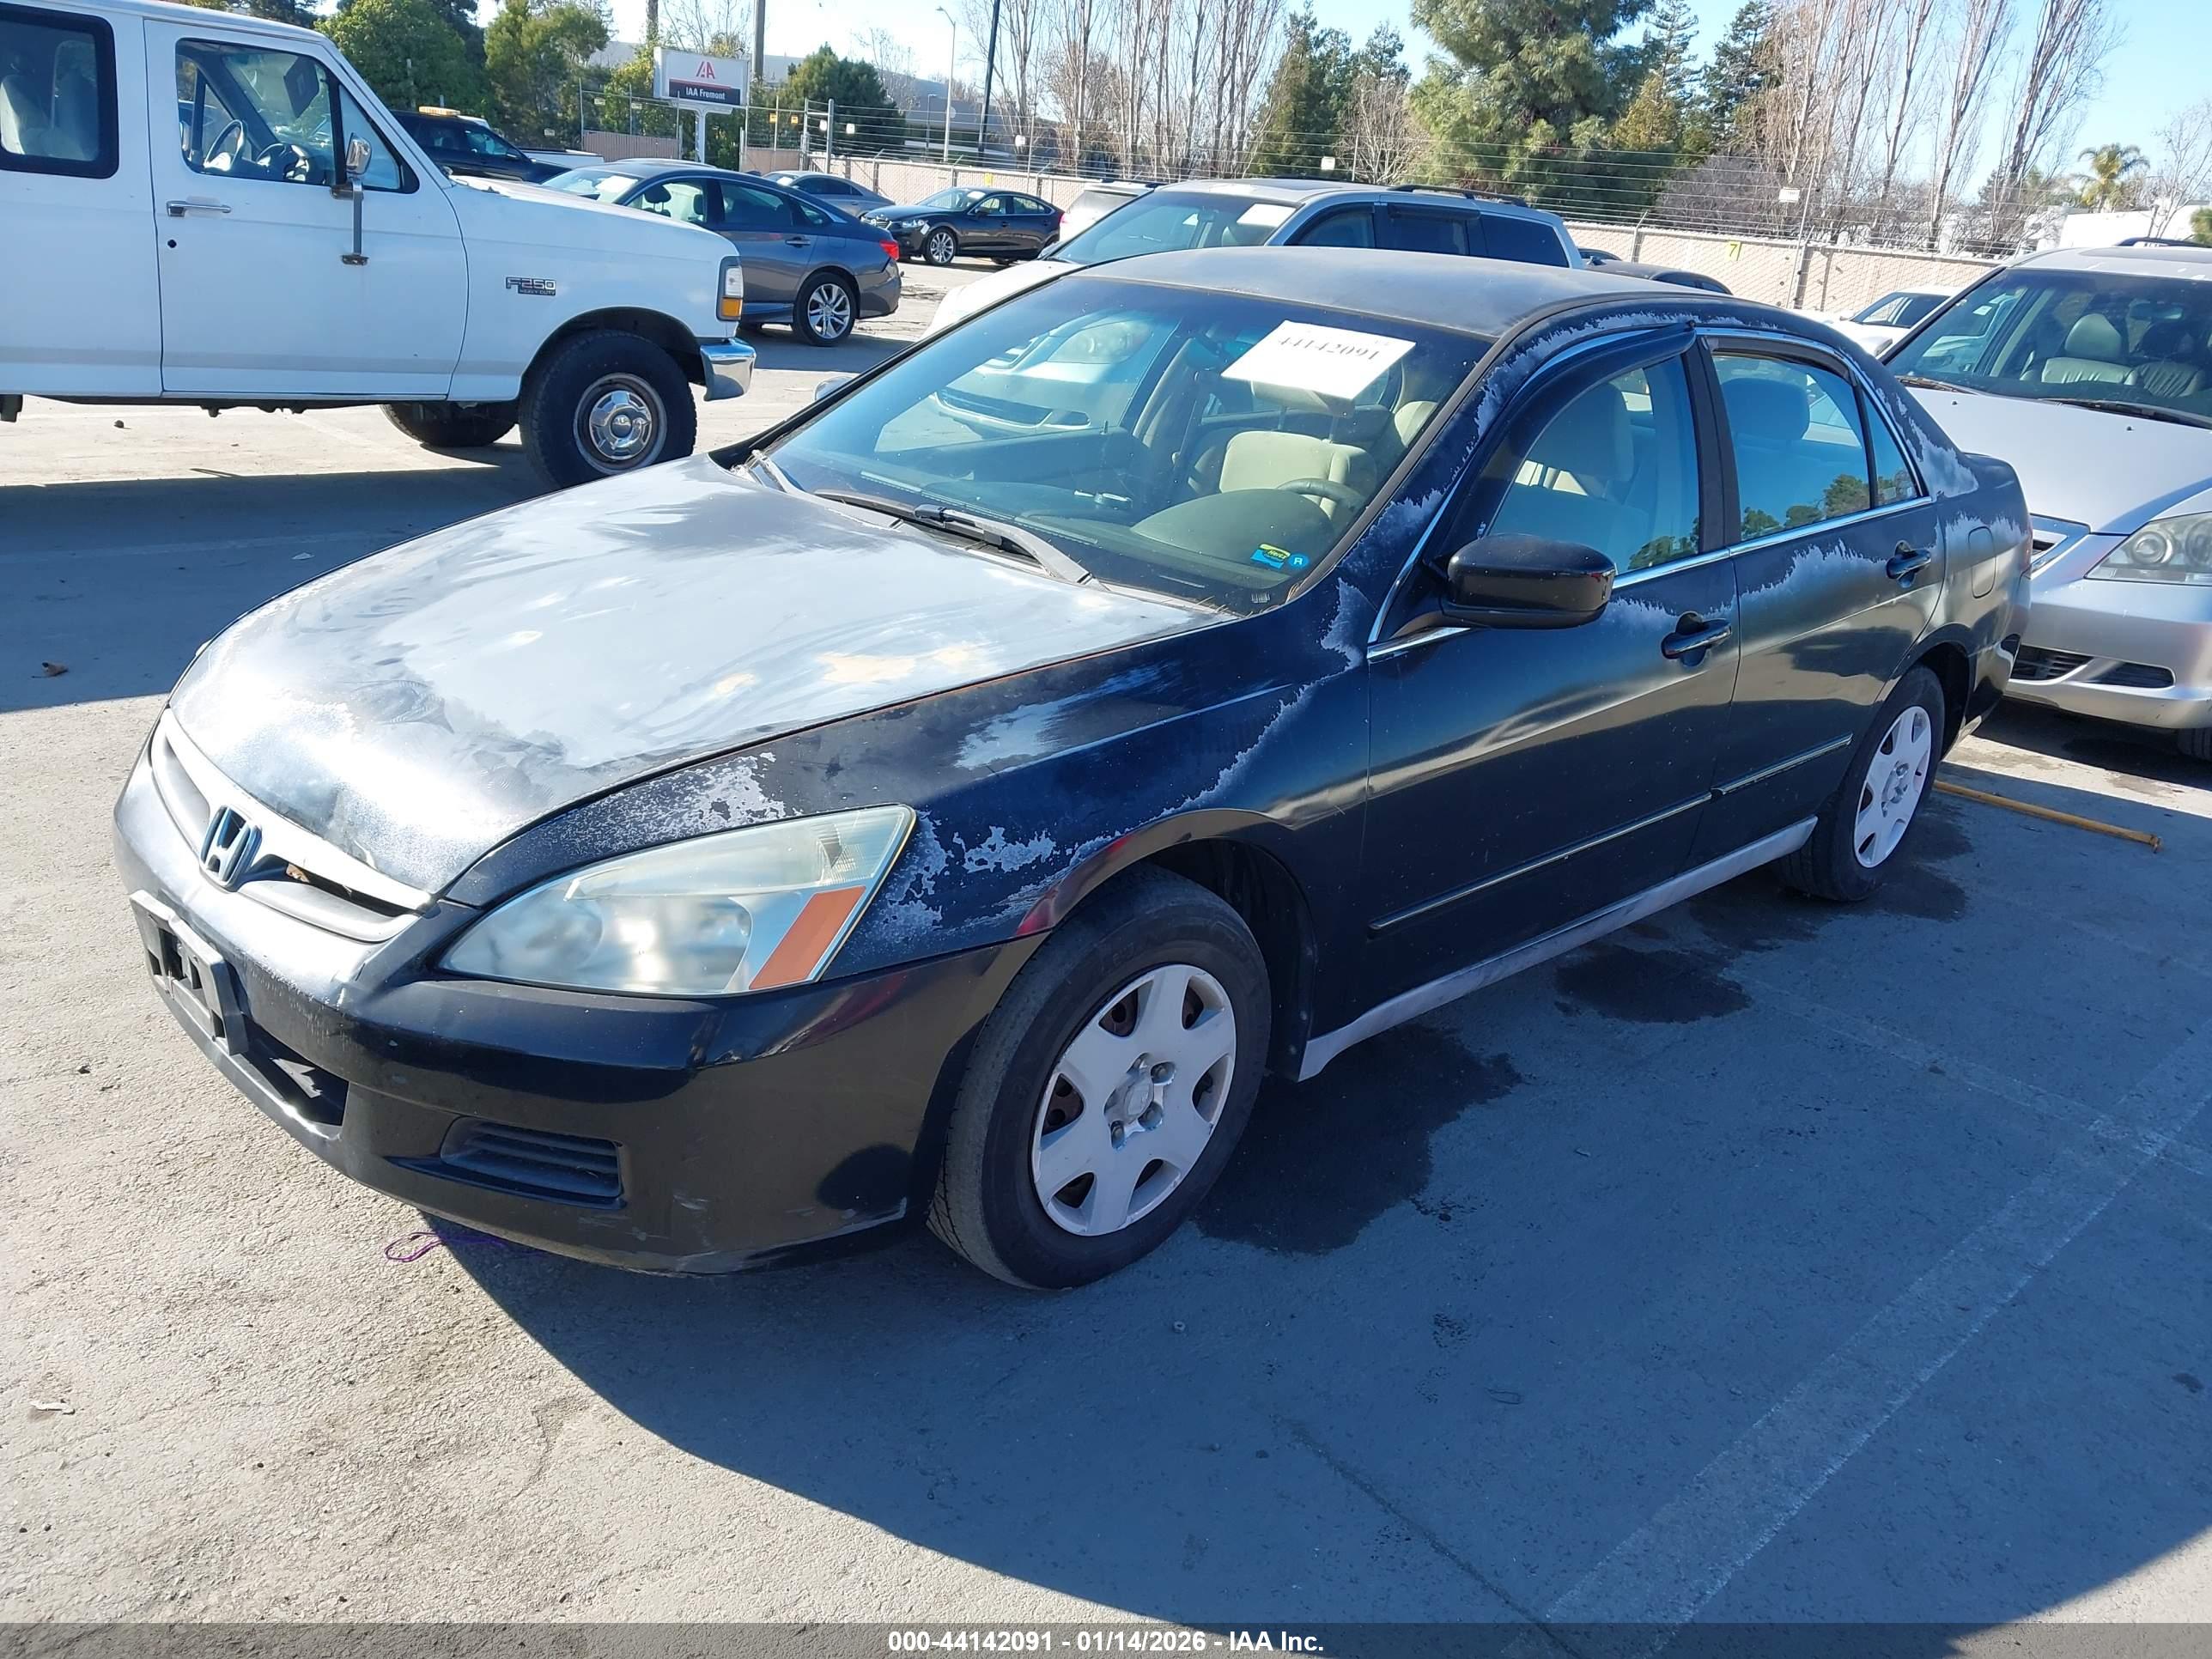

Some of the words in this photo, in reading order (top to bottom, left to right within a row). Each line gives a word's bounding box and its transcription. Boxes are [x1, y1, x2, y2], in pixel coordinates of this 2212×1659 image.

[685, 87, 698, 96] IAA
[699, 88, 725, 100] Fremont
[1729, 243, 1738, 258] 7
[506, 276, 556, 290] F250
[1278, 336, 1381, 361] 44142091
